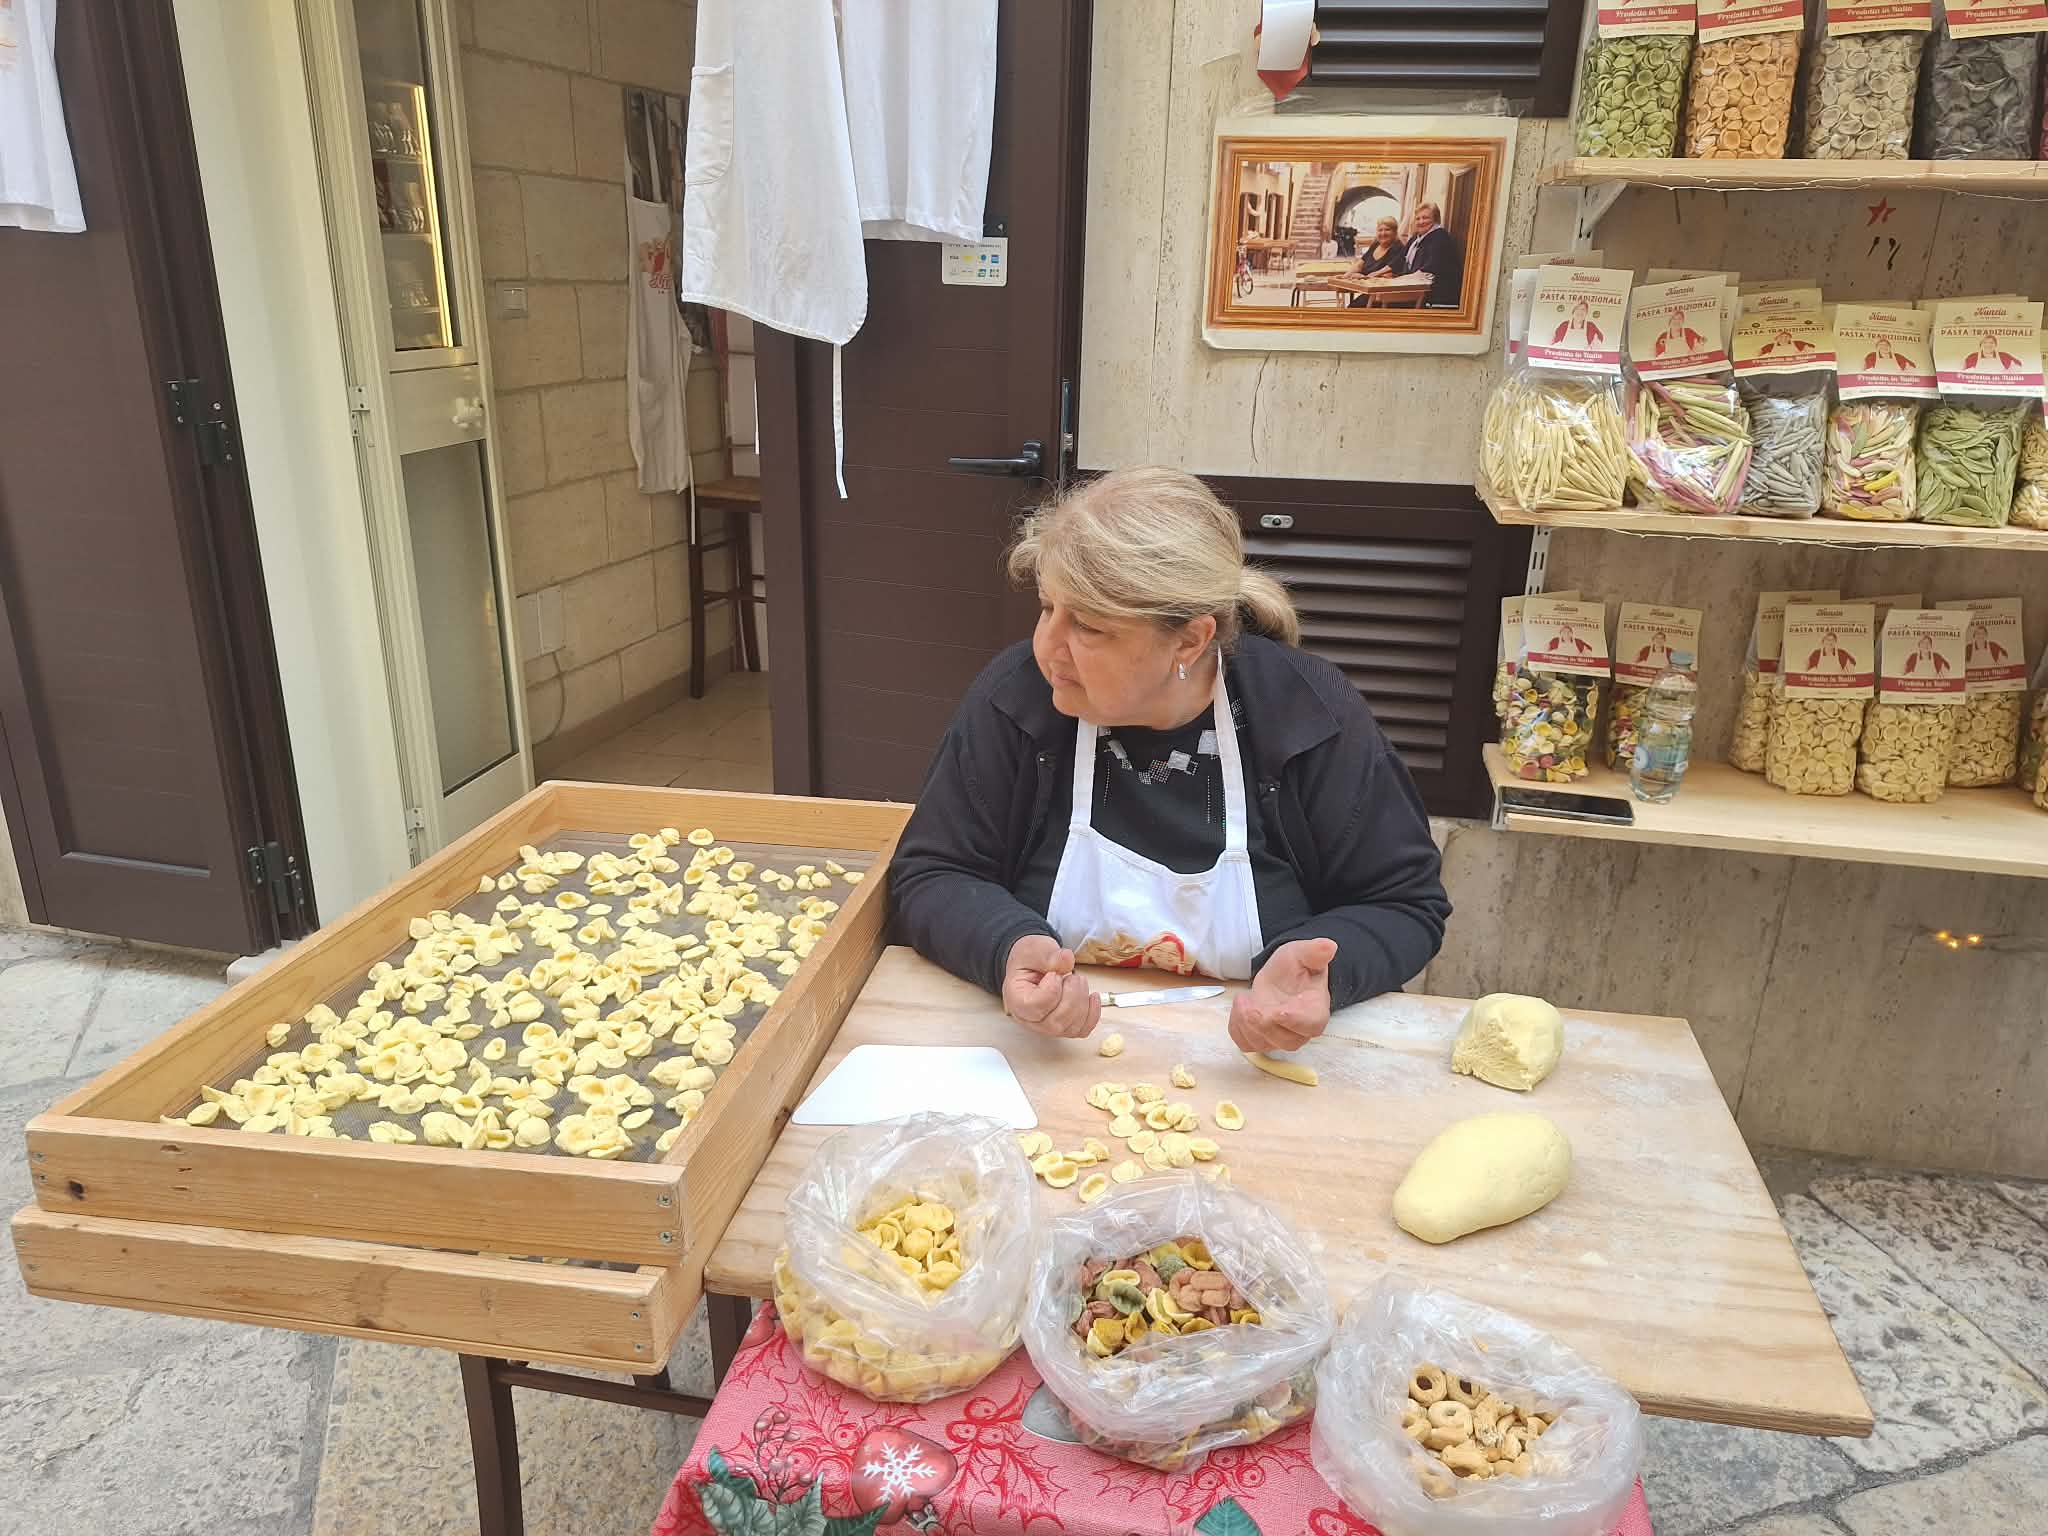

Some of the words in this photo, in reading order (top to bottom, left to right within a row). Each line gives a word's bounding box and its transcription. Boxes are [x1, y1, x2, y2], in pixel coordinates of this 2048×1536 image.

[1648, 8, 1656, 16] in
[1658, 7, 1678, 15] Italia
[1762, 6, 1784, 14] Italia
[1568, 294, 1622, 304] TRADIZIONALE
[1636, 310, 1660, 319] PASTA
[1664, 301, 1716, 313] TRADIZIONALE
[1868, 332, 1921, 342] TRADIZIONALE
